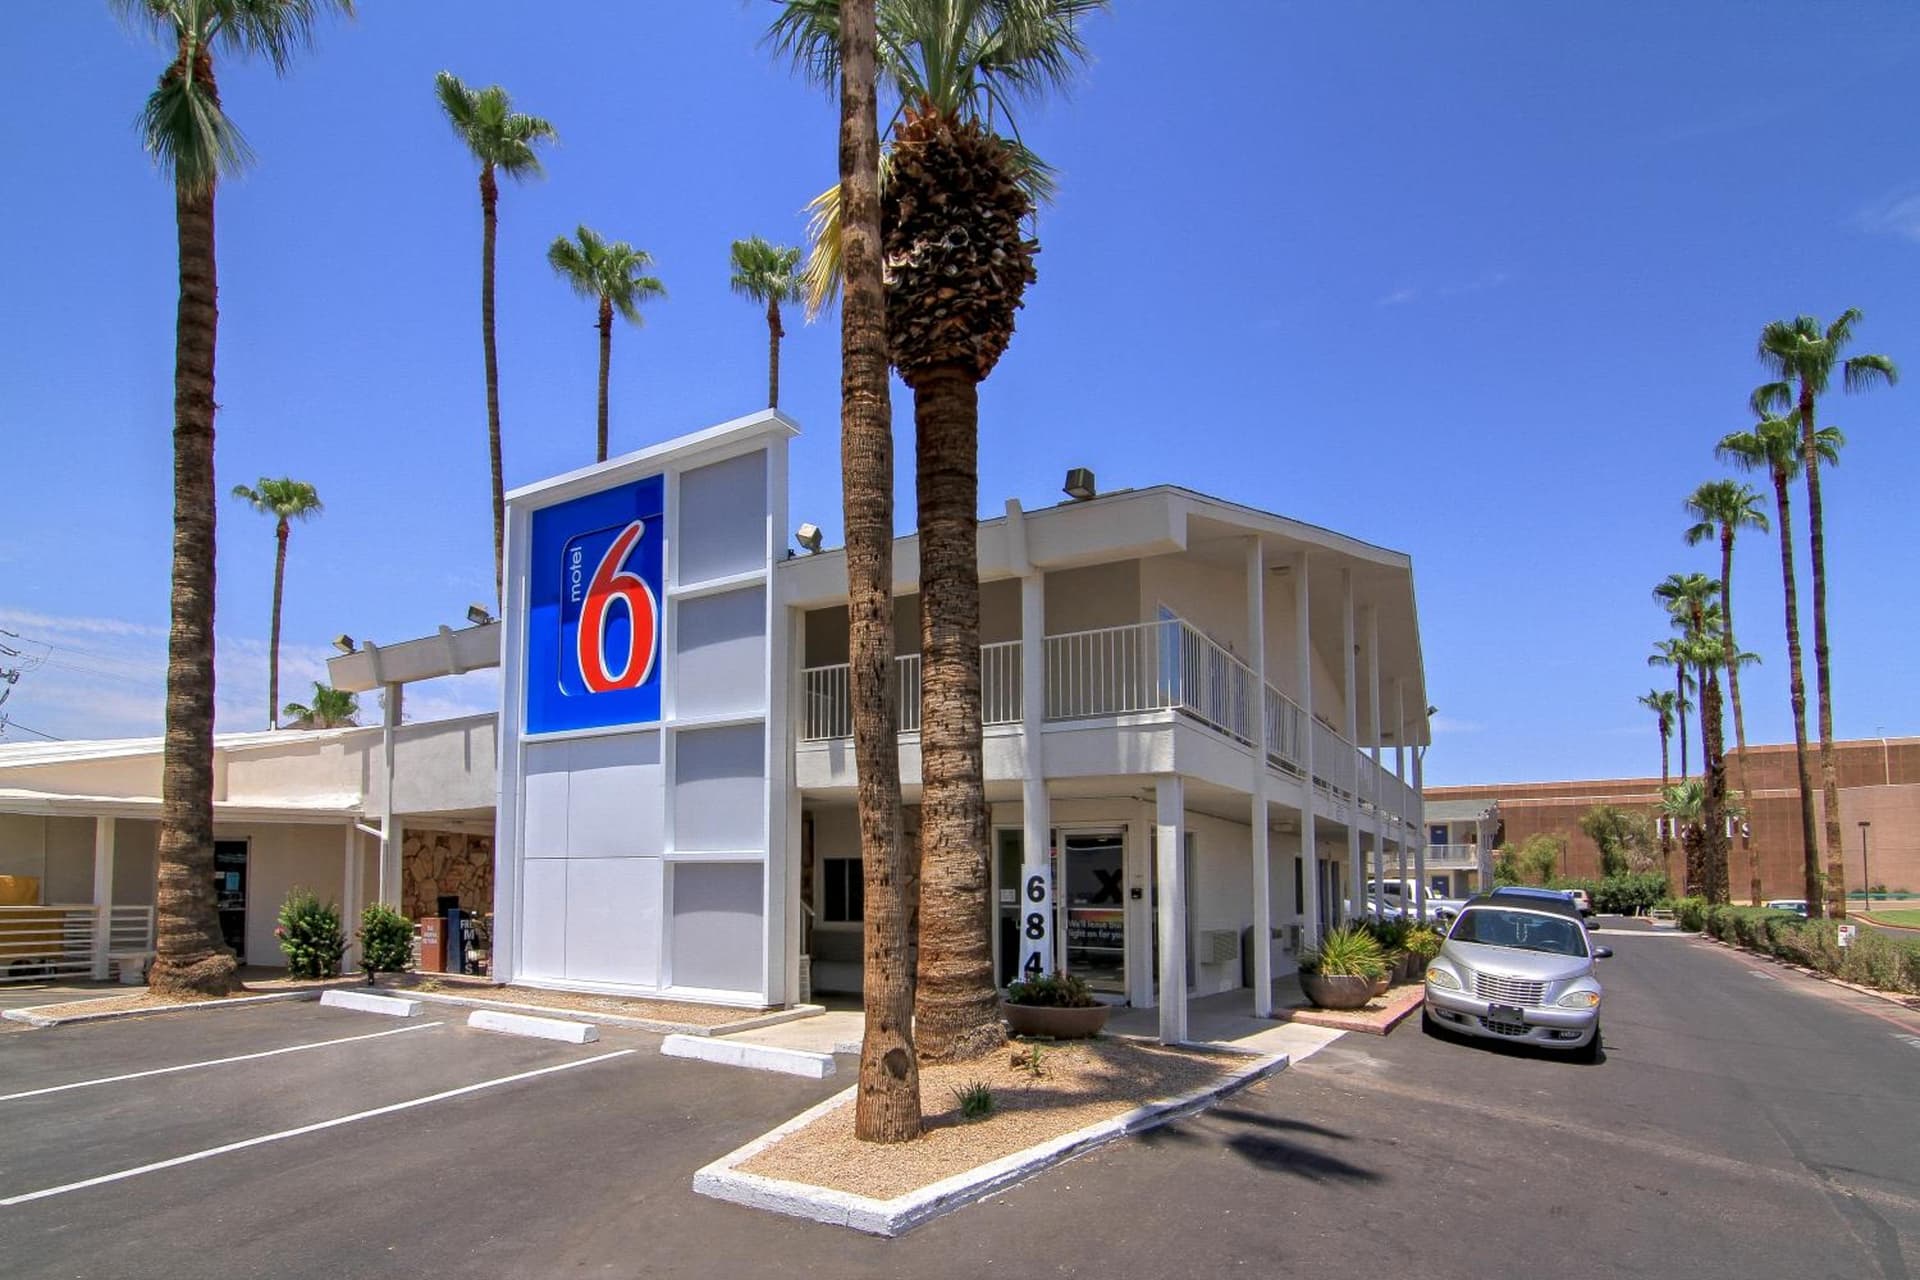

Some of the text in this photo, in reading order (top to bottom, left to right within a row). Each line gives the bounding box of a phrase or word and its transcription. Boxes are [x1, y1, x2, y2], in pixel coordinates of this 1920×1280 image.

[570, 519, 659, 693] motel 6
[1024, 875, 1046, 974] 684
